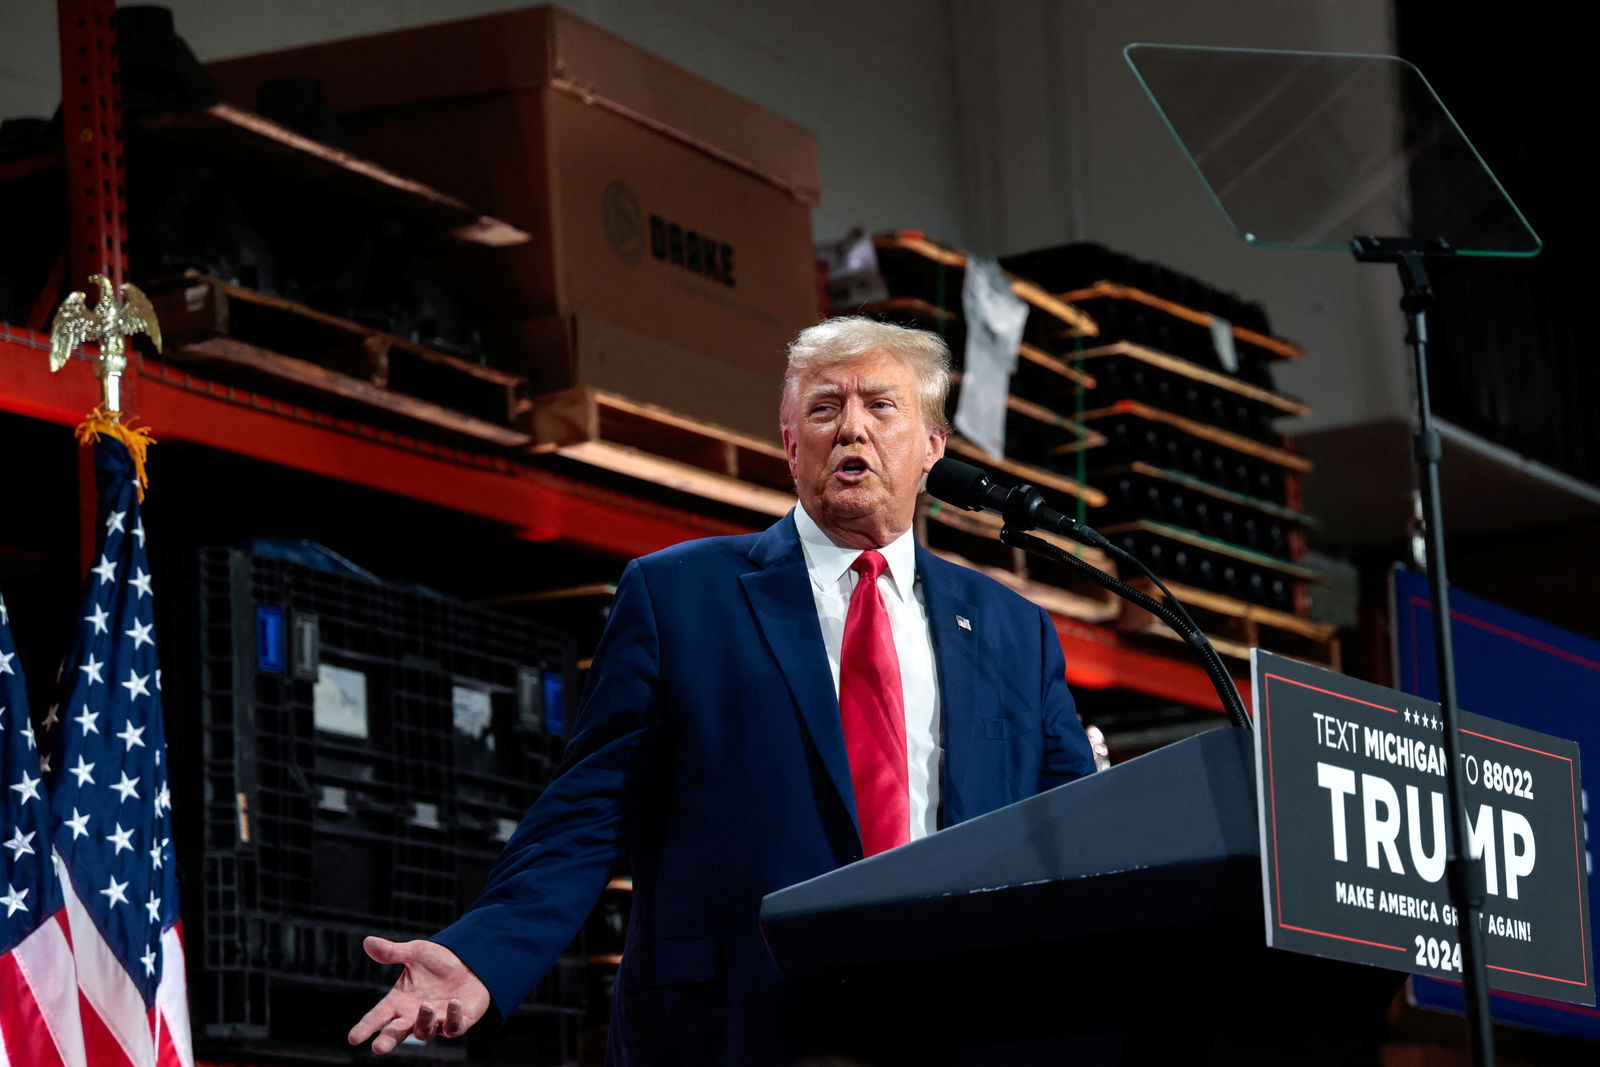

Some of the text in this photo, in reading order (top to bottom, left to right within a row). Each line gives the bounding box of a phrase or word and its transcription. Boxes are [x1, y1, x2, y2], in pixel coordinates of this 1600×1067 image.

[649, 214, 736, 287] DRAKE
[1313, 712, 1359, 754] TEXT
[1483, 759, 1534, 800] 88022
[1317, 761, 1536, 900] TRUMP
[1335, 881, 1375, 910] MAKE
[1379, 891, 1440, 923] AMERICA
[1488, 914, 1532, 942] AGAIN!
[1414, 935, 1463, 973] 2024
